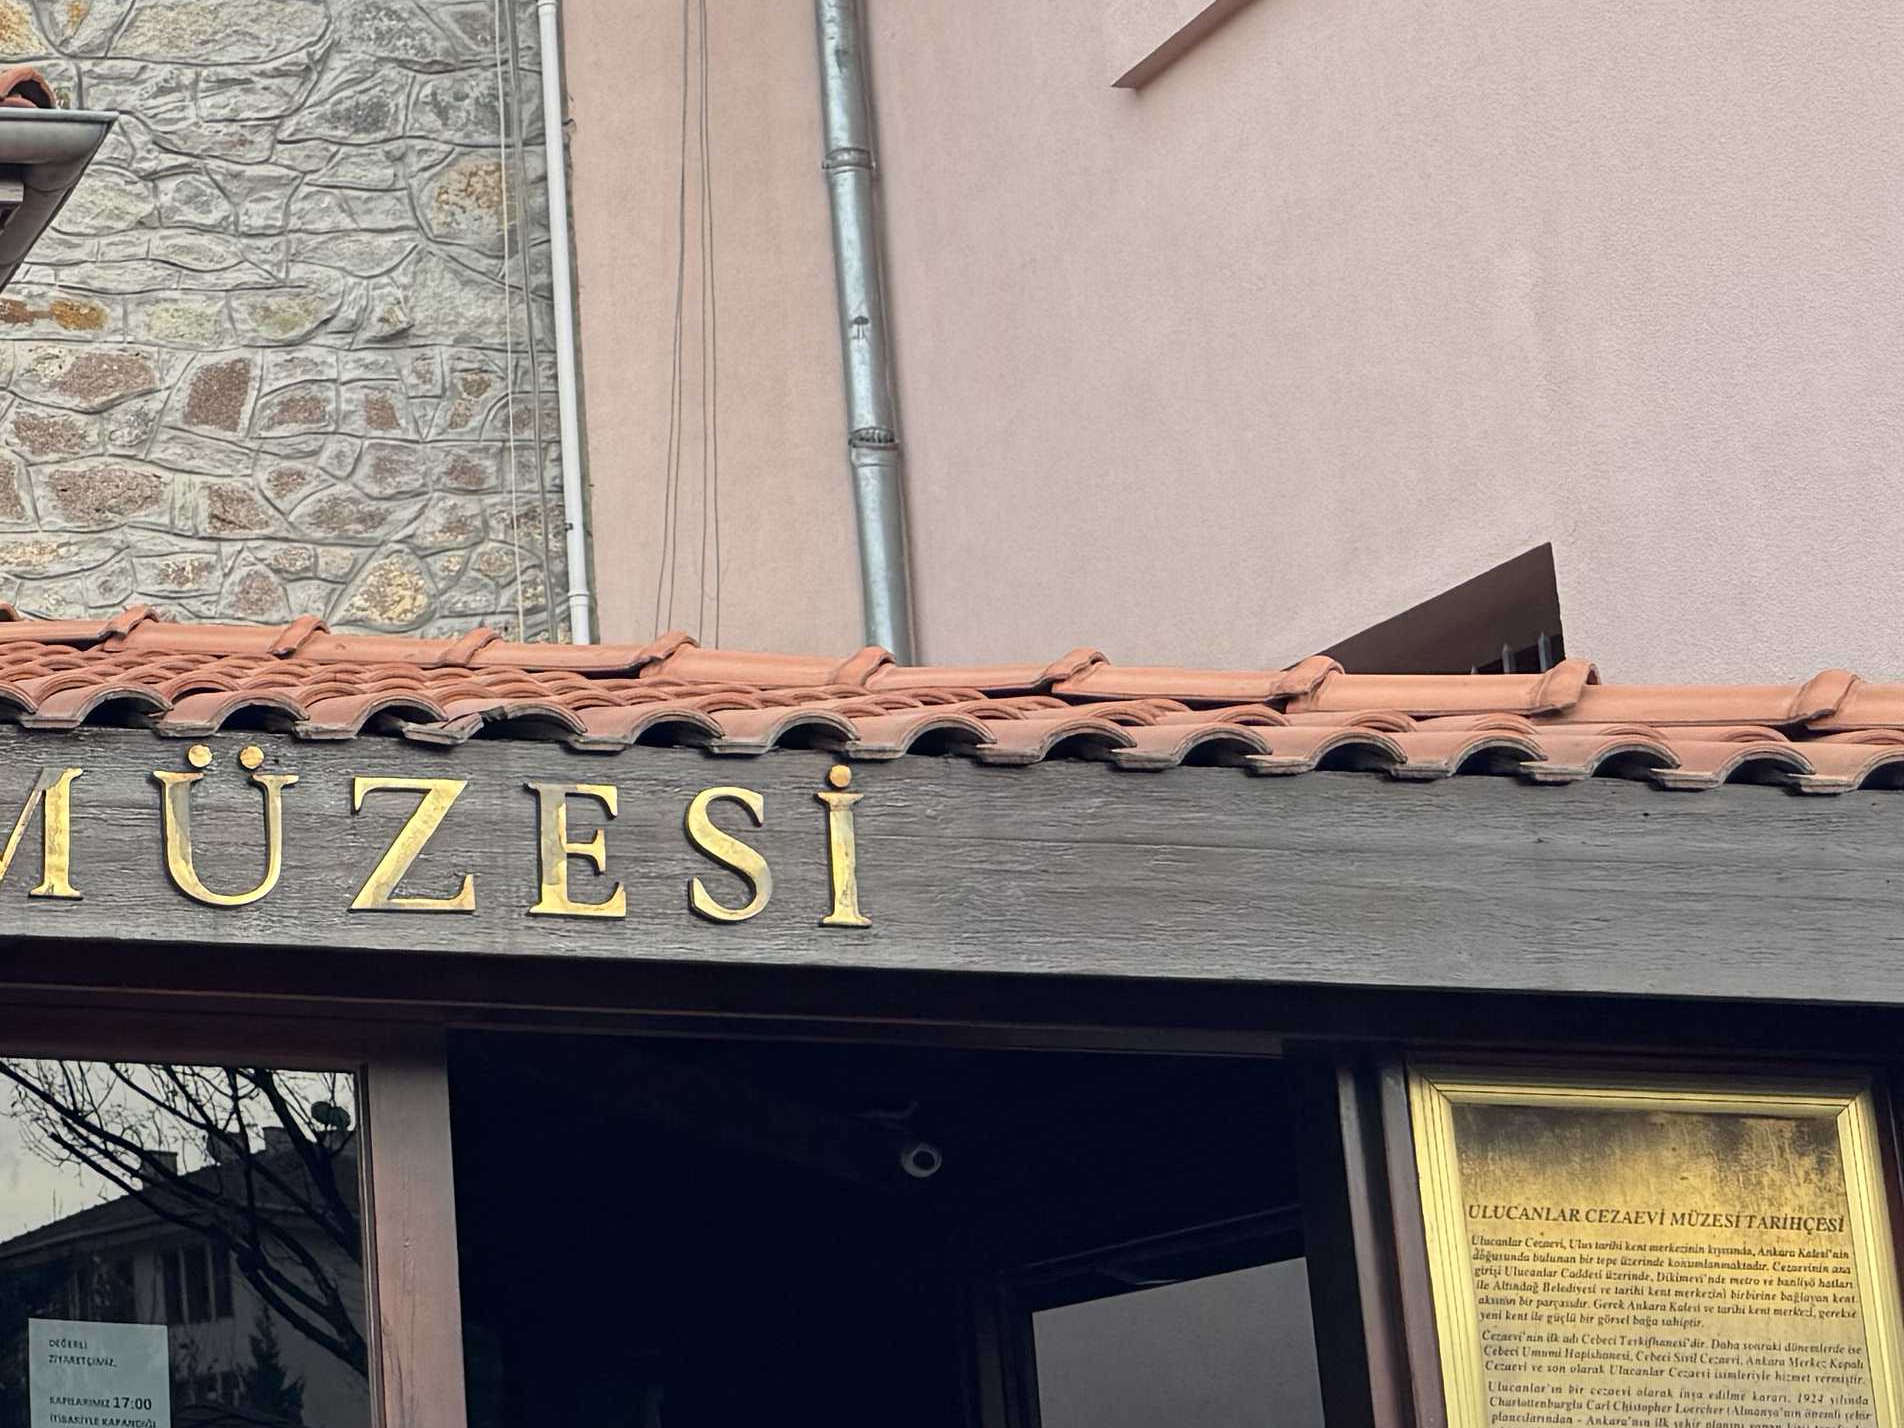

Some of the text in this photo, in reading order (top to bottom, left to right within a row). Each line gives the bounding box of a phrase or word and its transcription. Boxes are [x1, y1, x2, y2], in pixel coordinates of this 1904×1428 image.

[1468, 1204, 1844, 1232] ULUCANLAR CEZAEVİ MÜZESİ TARİHÇESİ
[1579, 1255, 1593, 1265] bir
[1711, 1339, 1740, 1350] Daha
[1568, 1385, 1584, 1395] bir
[1636, 1387, 1673, 1398] olarak
[1797, 1393, 1823, 1403] 1924
[113, 1397, 152, 1410] 17:00
